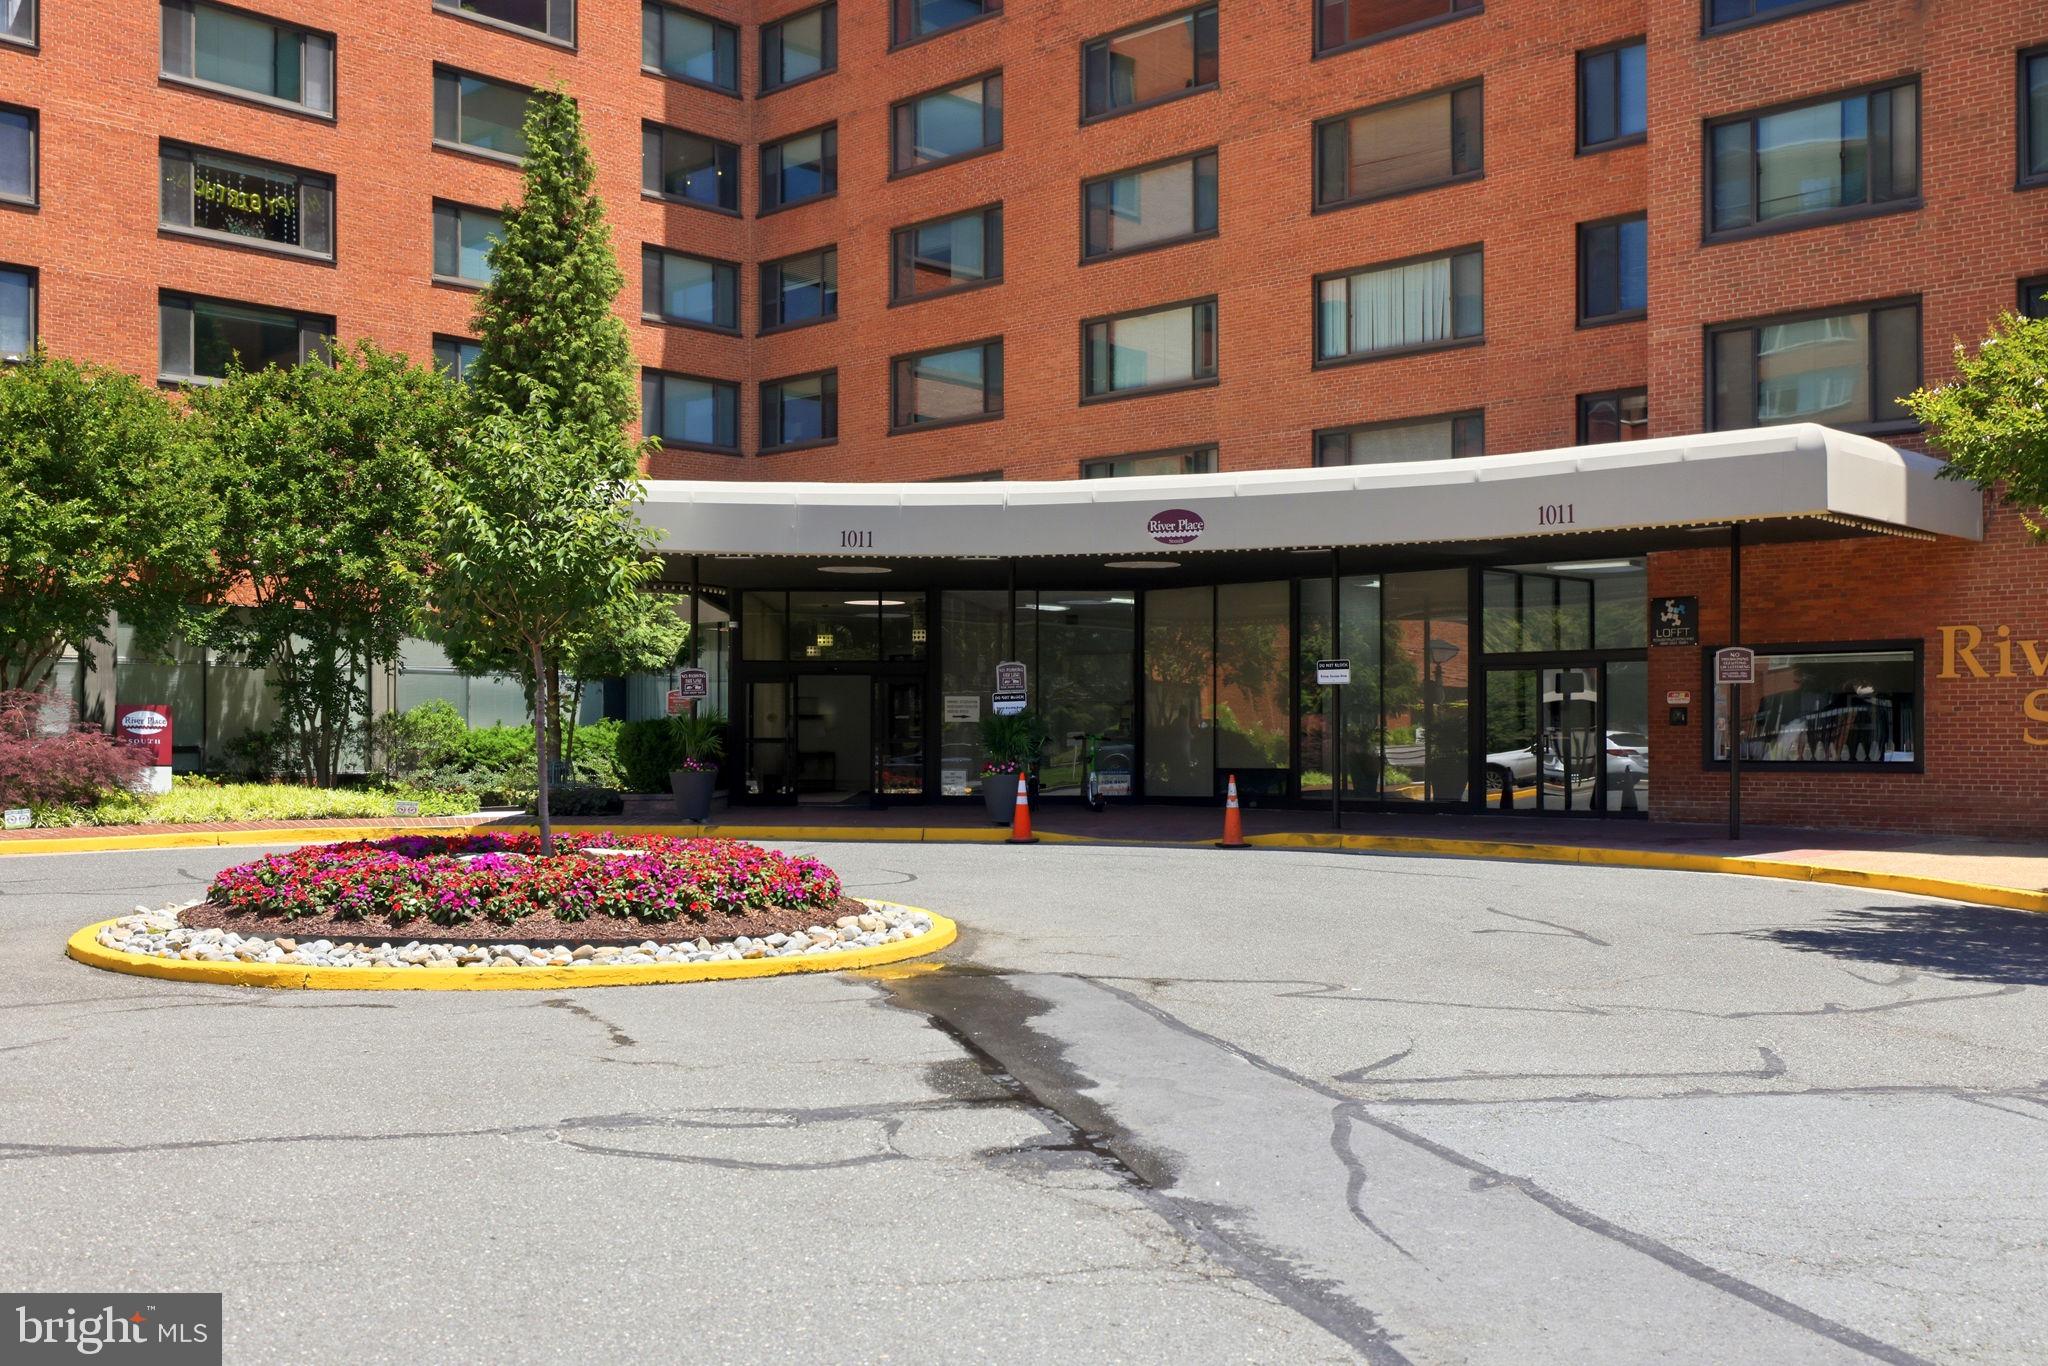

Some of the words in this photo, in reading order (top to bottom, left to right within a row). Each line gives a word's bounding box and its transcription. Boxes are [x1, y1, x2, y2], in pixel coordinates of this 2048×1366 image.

[1538, 503, 1575, 525] 1011
[1150, 520, 1176, 531] River
[1178, 519, 1204, 530] Place
[840, 530, 873, 547] 1011
[1656, 627, 1691, 638] LOFFT
[124, 716, 145, 725] River
[147, 716, 167, 724] Place
